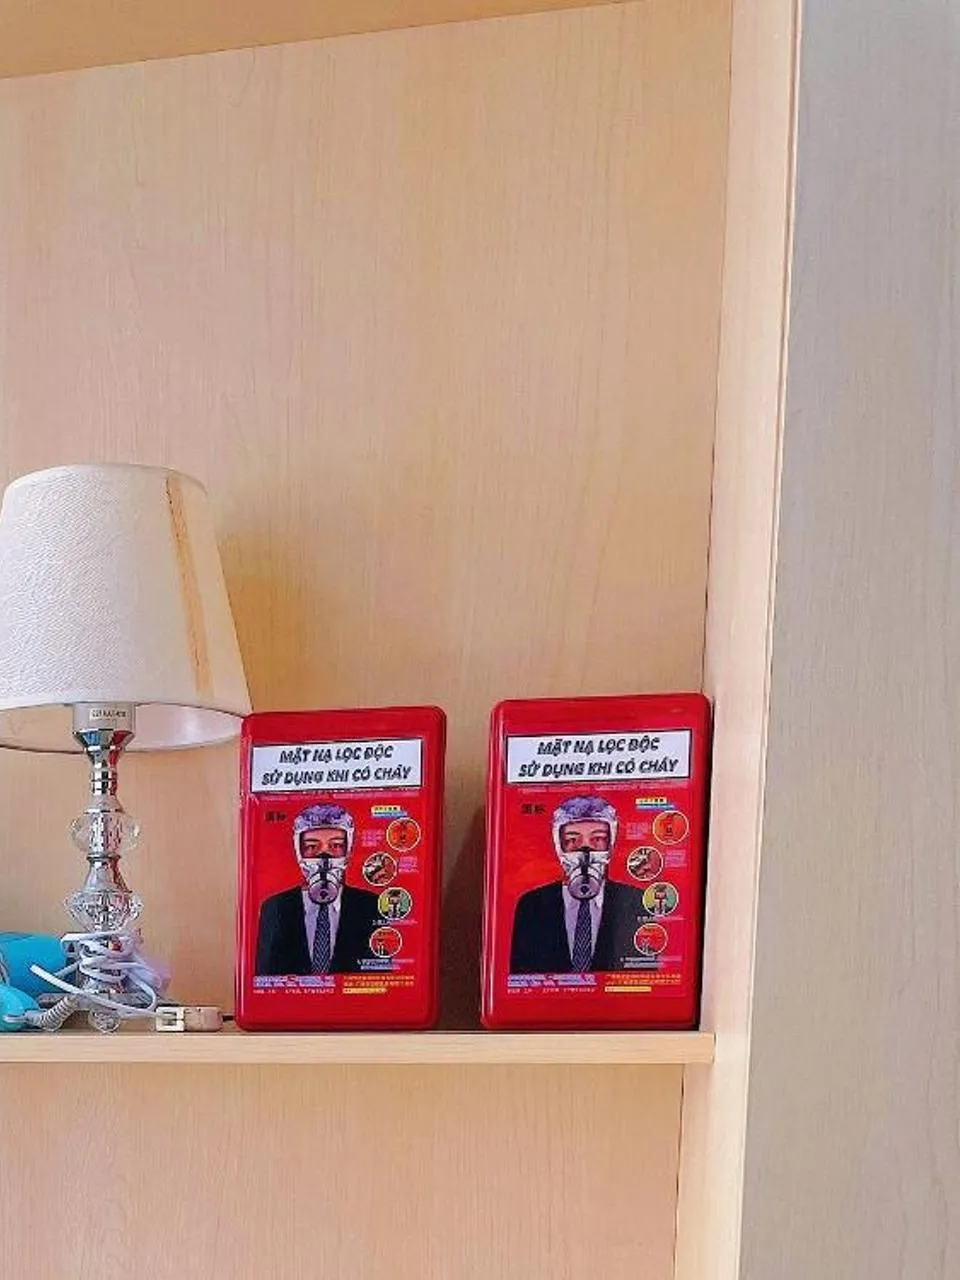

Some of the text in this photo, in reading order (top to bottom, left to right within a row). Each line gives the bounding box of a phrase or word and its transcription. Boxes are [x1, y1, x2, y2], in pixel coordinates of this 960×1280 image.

[312, 748, 332, 764] NẠ
[335, 746, 363, 763] LỌC
[364, 744, 394, 762] ĐỘC
[573, 740, 594, 755] NẠ
[597, 738, 625, 755] LỌC
[627, 735, 660, 753] ĐỘC
[284, 770, 324, 786] DỤNG
[326, 769, 350, 783] KHI
[352, 766, 371, 782] CÓ
[542, 762, 585, 778] DỤNG
[587, 761, 612, 775] KHI
[615, 757, 636, 774] CÓ
[639, 756, 679, 773] CHÁY
